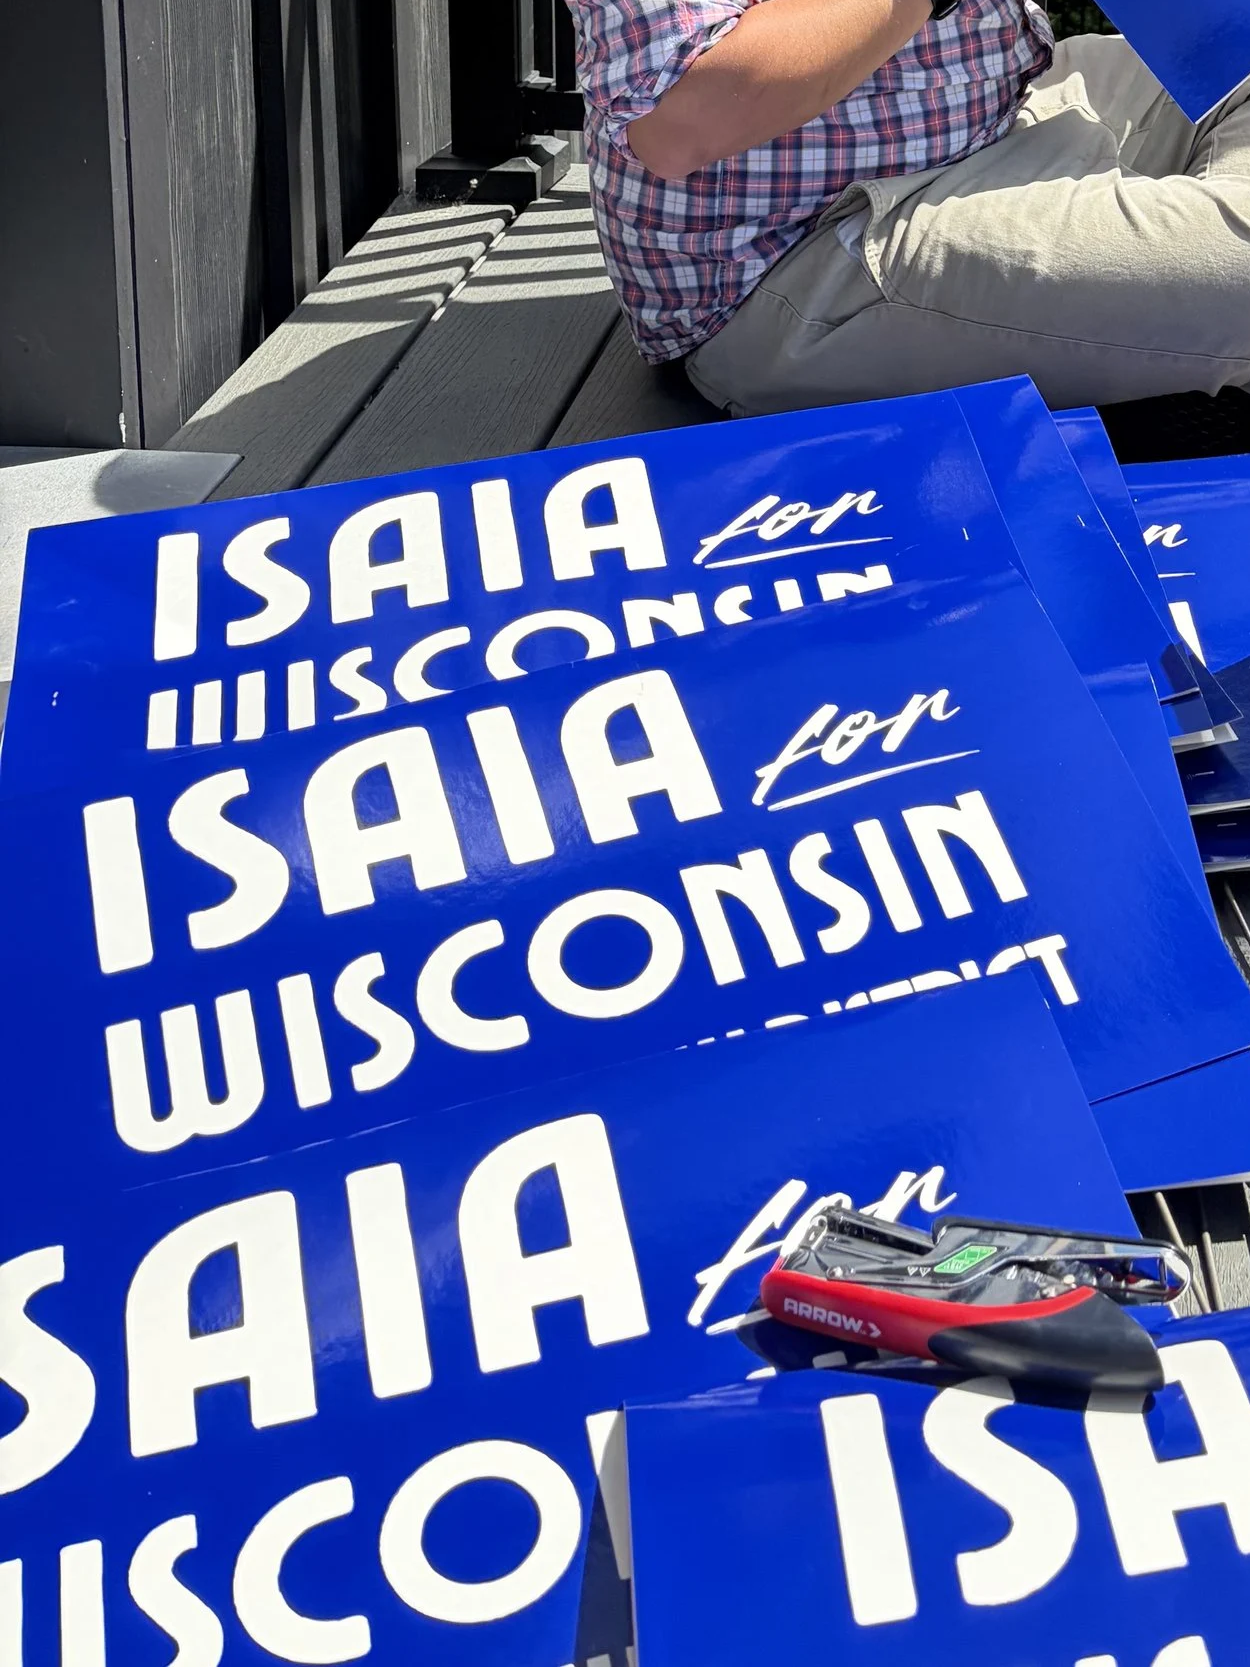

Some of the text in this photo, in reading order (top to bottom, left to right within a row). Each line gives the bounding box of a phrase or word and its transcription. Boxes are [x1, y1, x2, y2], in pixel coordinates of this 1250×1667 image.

[154, 458, 883, 661] ISAIA for
[83, 670, 960, 974] ISAIA for
[106, 790, 1028, 1152] WISCONSIN
[784, 1298, 864, 1333] ARROW
